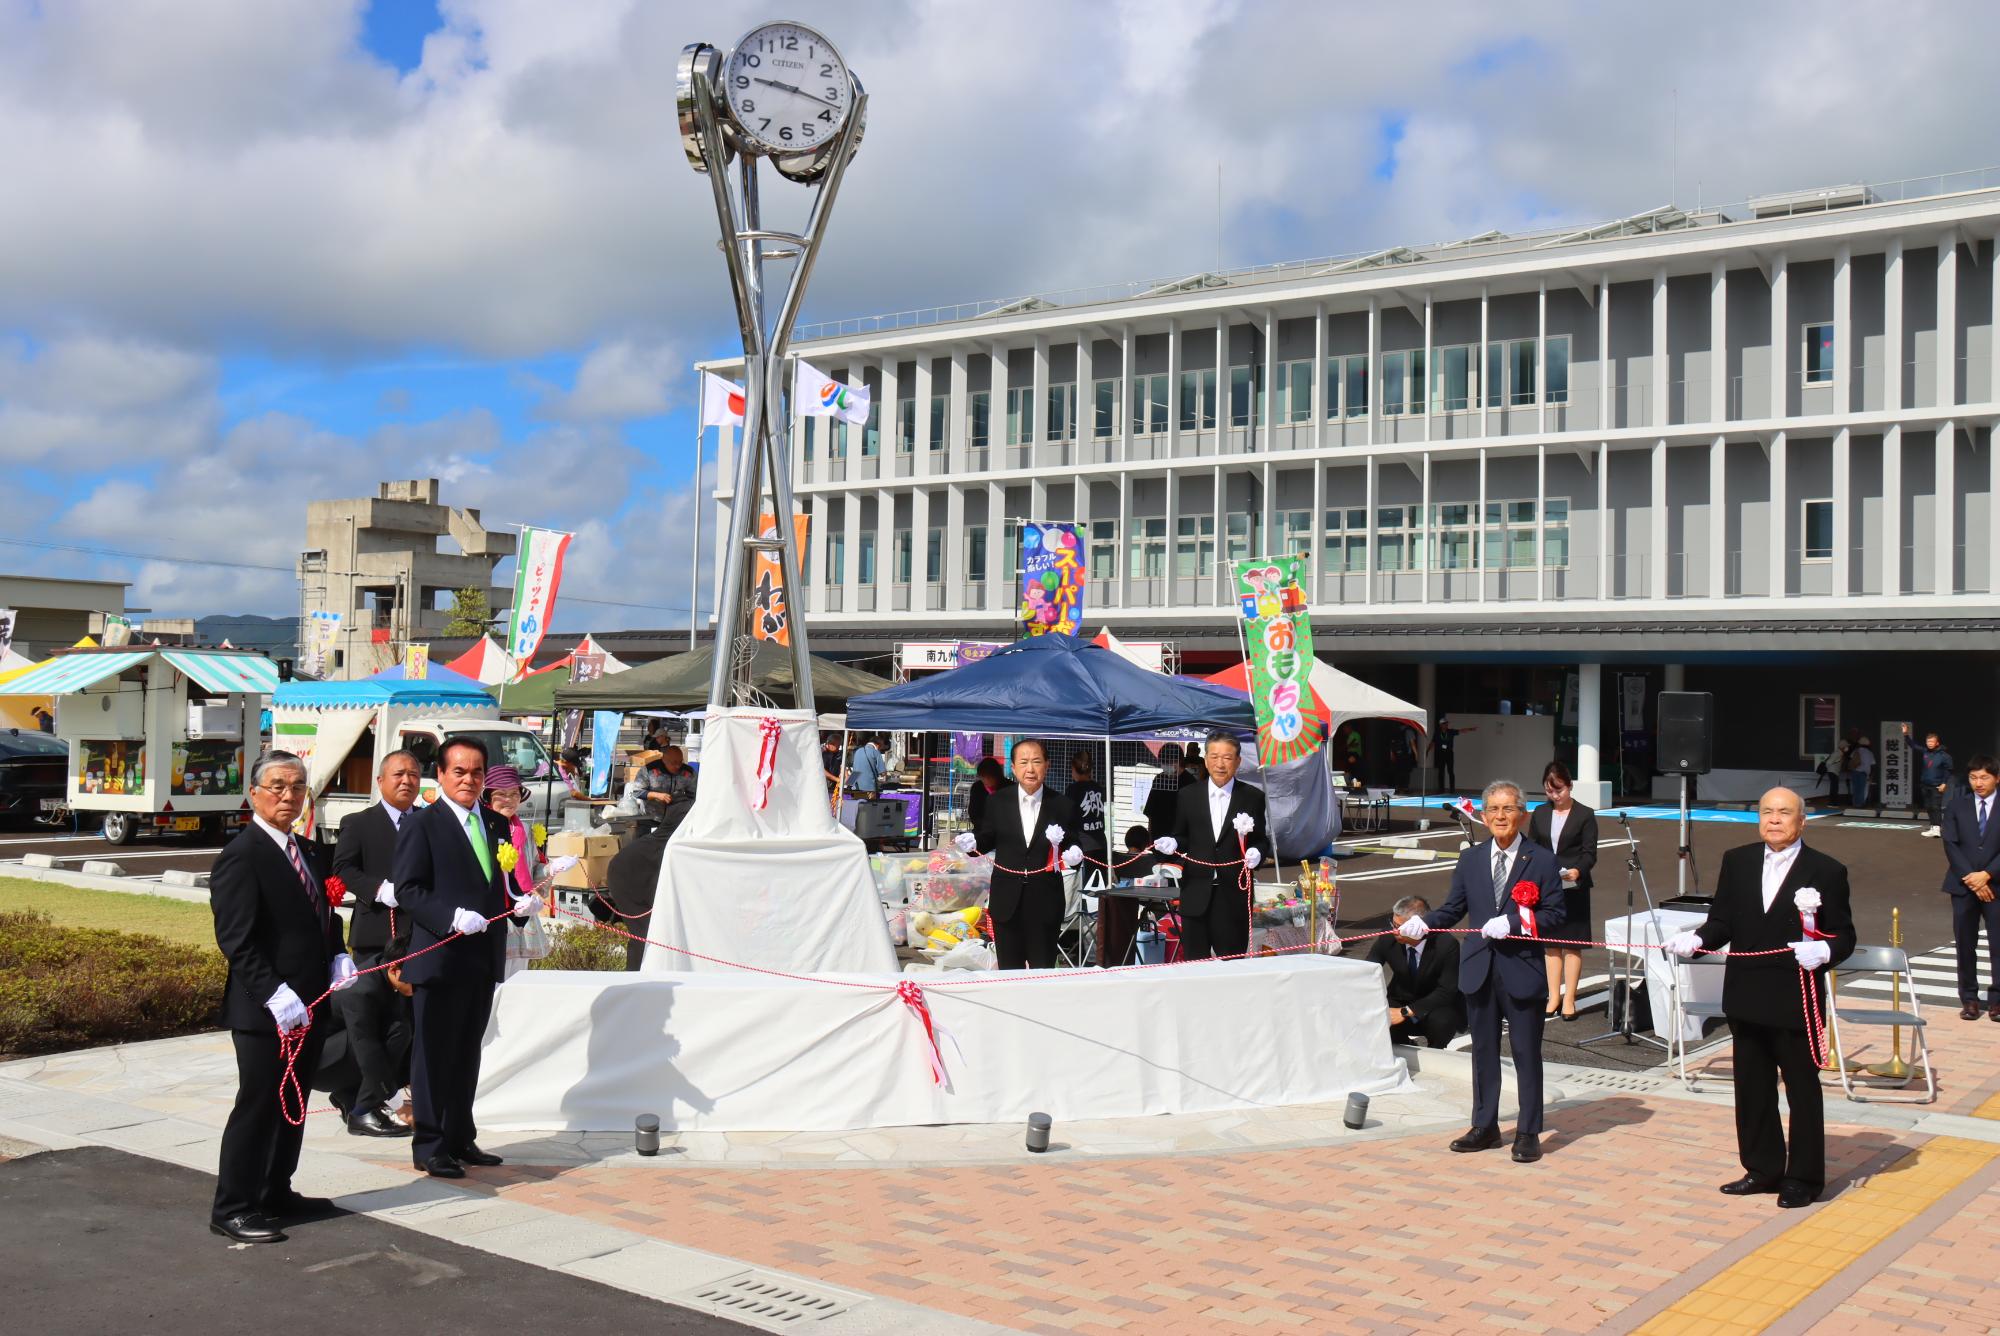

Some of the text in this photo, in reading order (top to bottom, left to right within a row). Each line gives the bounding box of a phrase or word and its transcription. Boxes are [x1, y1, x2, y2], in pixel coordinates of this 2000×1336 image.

[758, 38, 774, 54] 11
[780, 35, 799, 51] 12
[808, 45, 814, 59] 1
[742, 53, 761, 68] 10
[772, 59, 804, 69] CITIZEN
[819, 64, 833, 78] 2
[736, 75, 750, 89] 9
[825, 87, 838, 100] 3
[741, 99, 755, 113] 8
[817, 109, 832, 123] 4
[758, 117, 772, 131] 7
[801, 122, 815, 137] 5
[779, 126, 793, 141] 6
[1026, 553, 1057, 565] カラフル
[1269, 621, 1299, 737] おもちゃ
[1886, 739, 1899, 795] 総合案内
